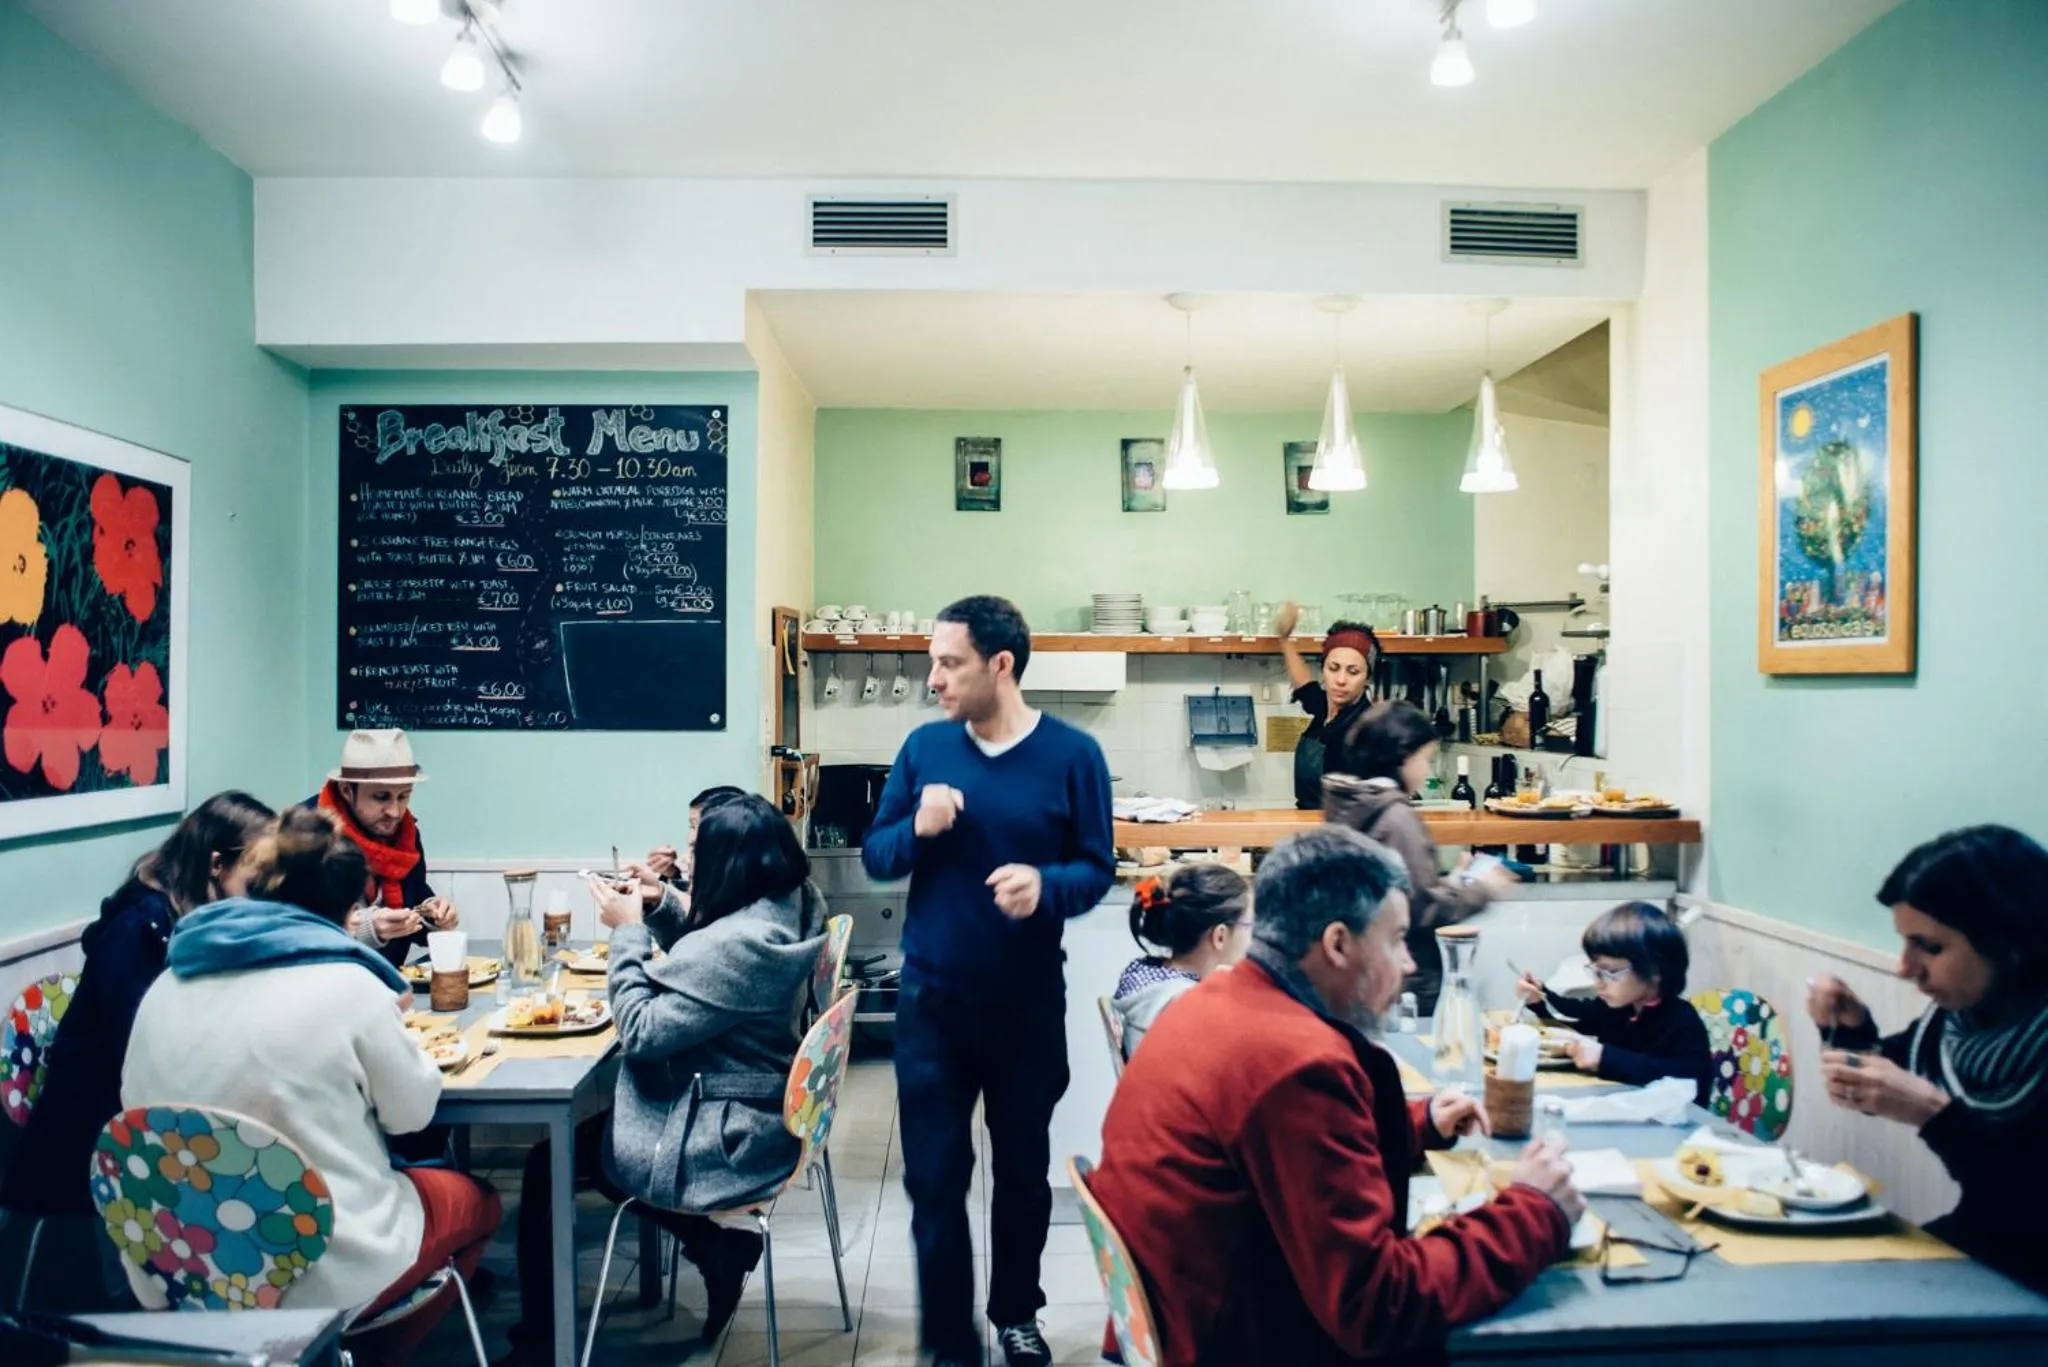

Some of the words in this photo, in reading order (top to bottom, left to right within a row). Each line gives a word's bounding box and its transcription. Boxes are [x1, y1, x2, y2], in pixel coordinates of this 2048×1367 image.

[375, 407, 570, 466] Breakfast
[586, 409, 700, 455] Menu
[546, 457, 591, 479] 7.30
[487, 490, 524, 501] BREAD
[450, 579, 476, 591] WITH
[566, 581, 598, 593] FRUIT
[601, 583, 638, 594] SALAD
[402, 664, 430, 676] TOAST
[434, 665, 459, 676] WITH
